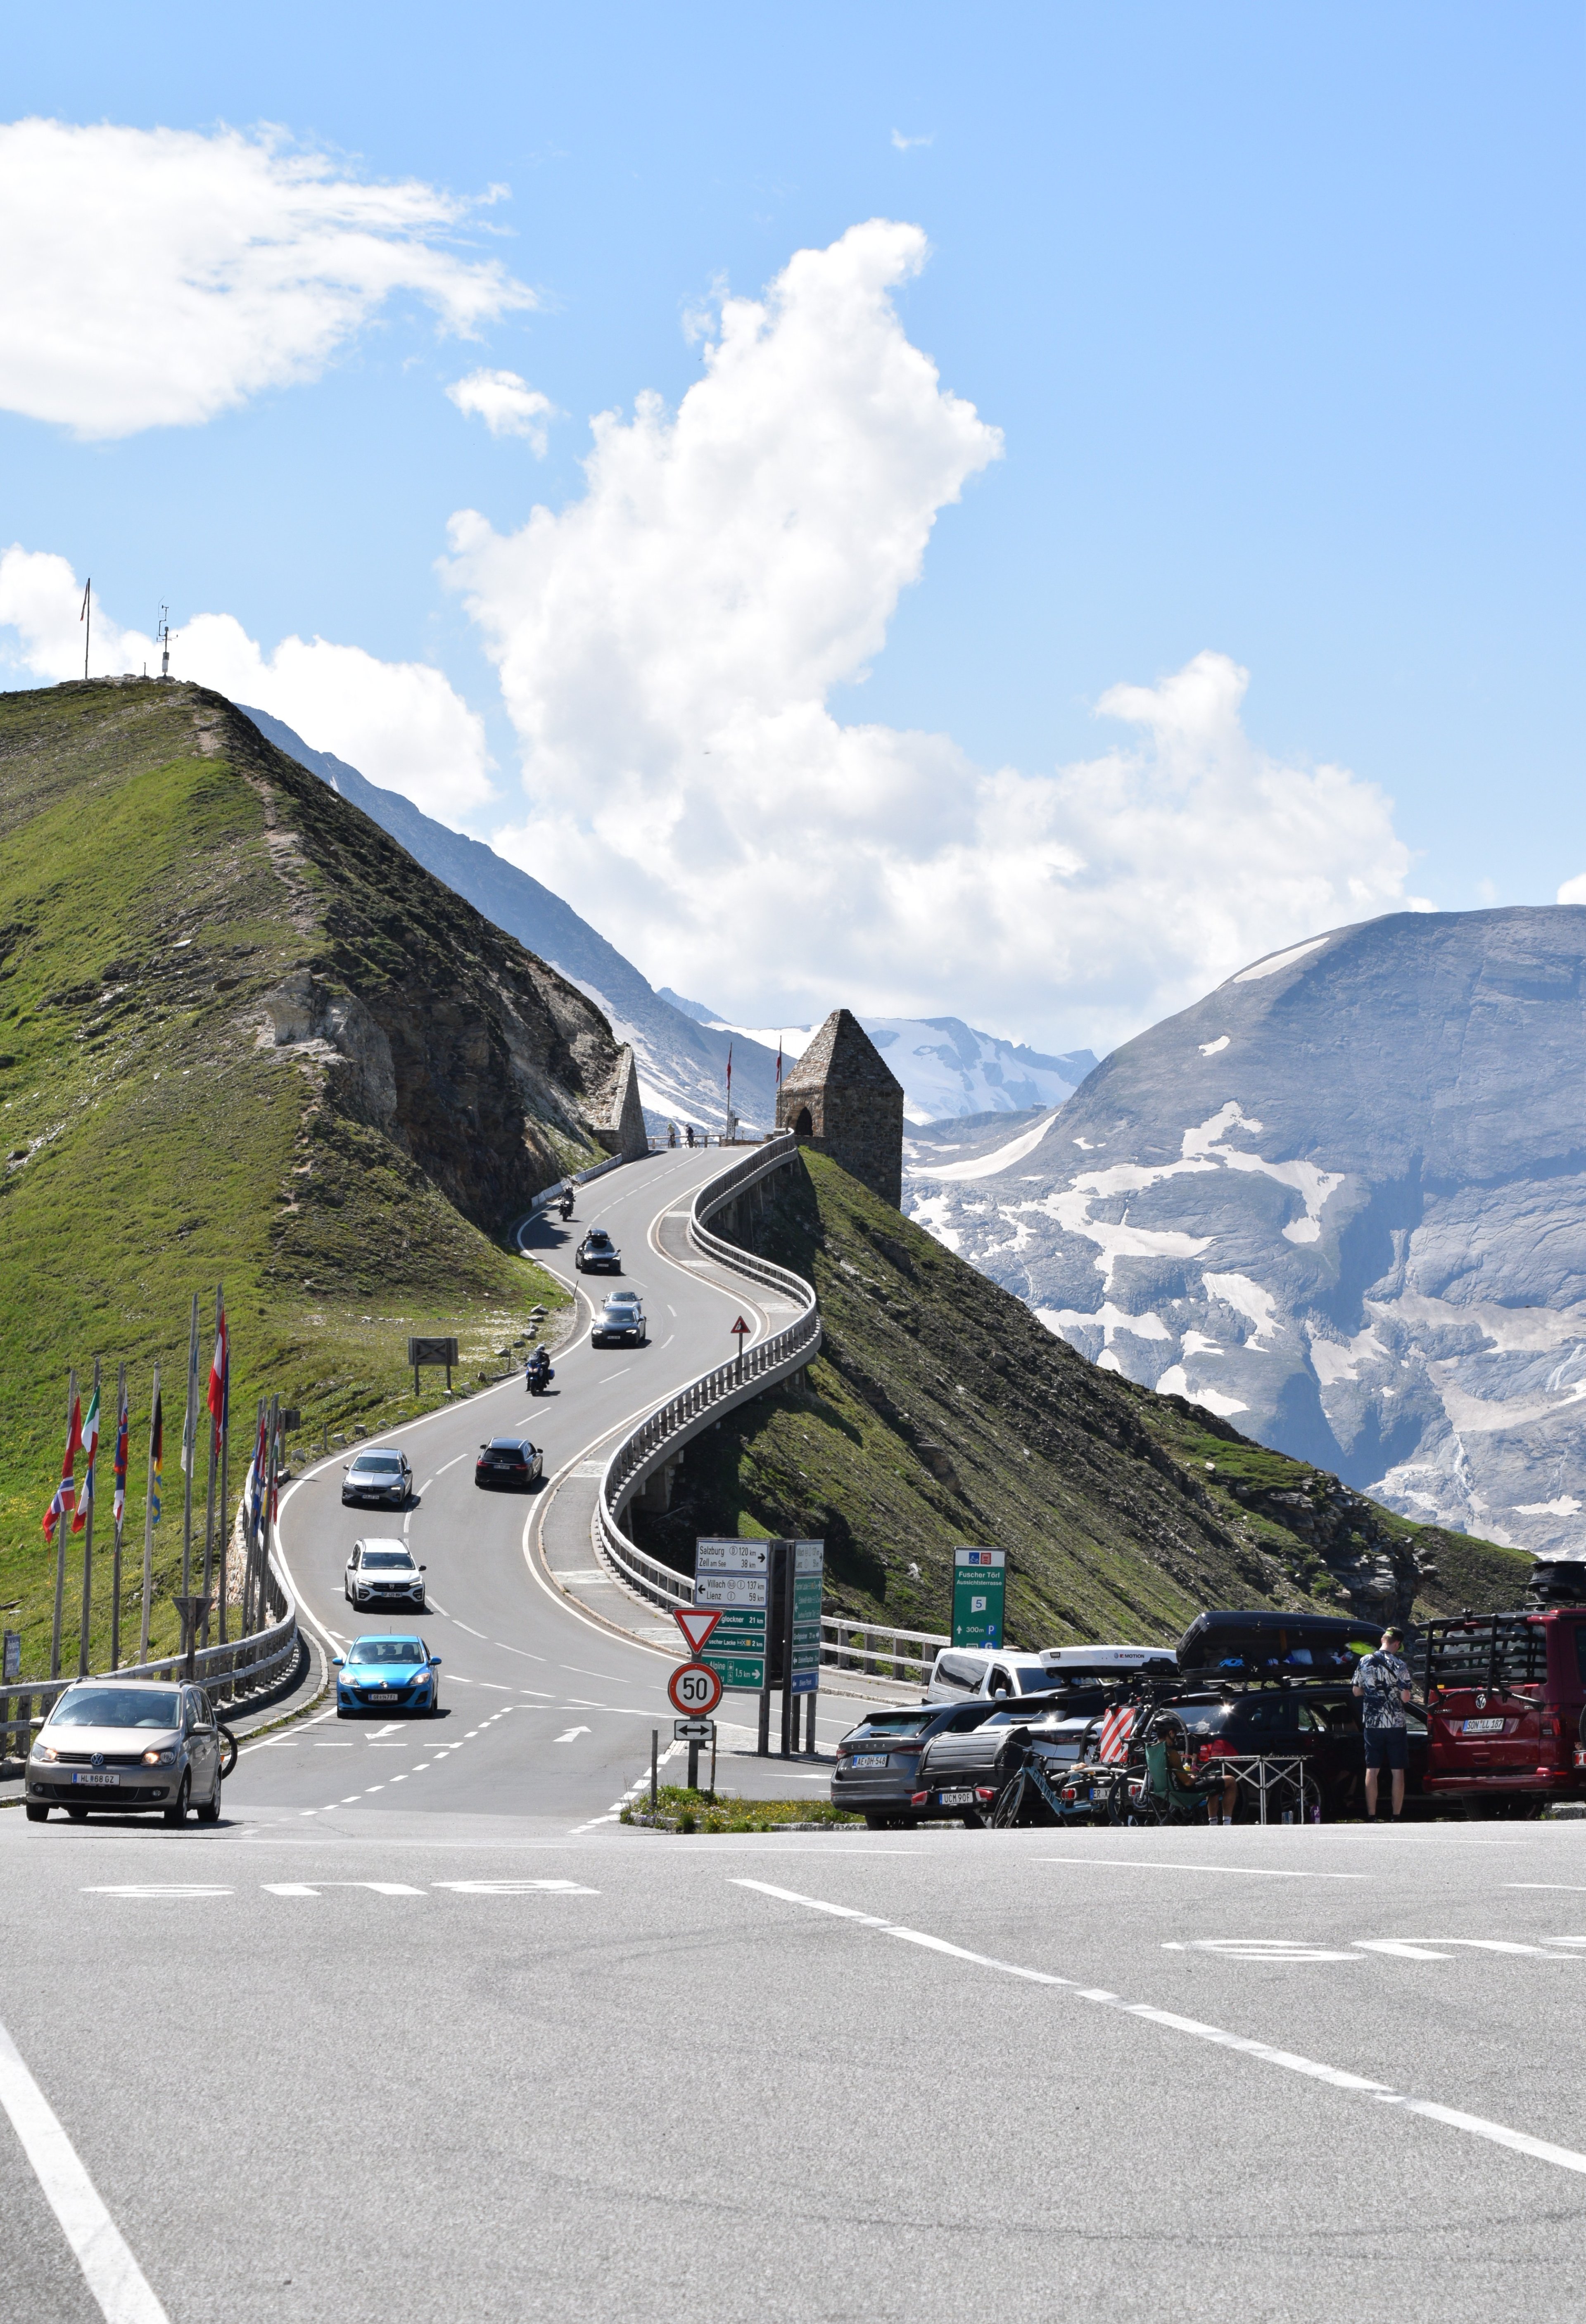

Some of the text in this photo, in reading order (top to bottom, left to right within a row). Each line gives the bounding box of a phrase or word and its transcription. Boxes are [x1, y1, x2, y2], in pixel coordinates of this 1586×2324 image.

[700, 1546, 724, 1557] Salzburg
[739, 1547, 748, 1556] 120
[699, 1558, 709, 1566] Zell
[741, 1559, 748, 1568] 38
[708, 1579, 725, 1588] Villach
[747, 1581, 757, 1589] 137
[707, 1591, 721, 1600] Lienz
[749, 1593, 756, 1601] 59
[976, 1599, 982, 1608] 5
[710, 1661, 725, 1669] Alpine
[683, 1677, 707, 1700] 50
[1467, 1719, 1503, 1730] SON LL 187
[1033, 1770, 1054, 1804] CANYON
[944, 1793, 969, 1803] UCM 90F
[1093, 1789, 1101, 1799] ER
